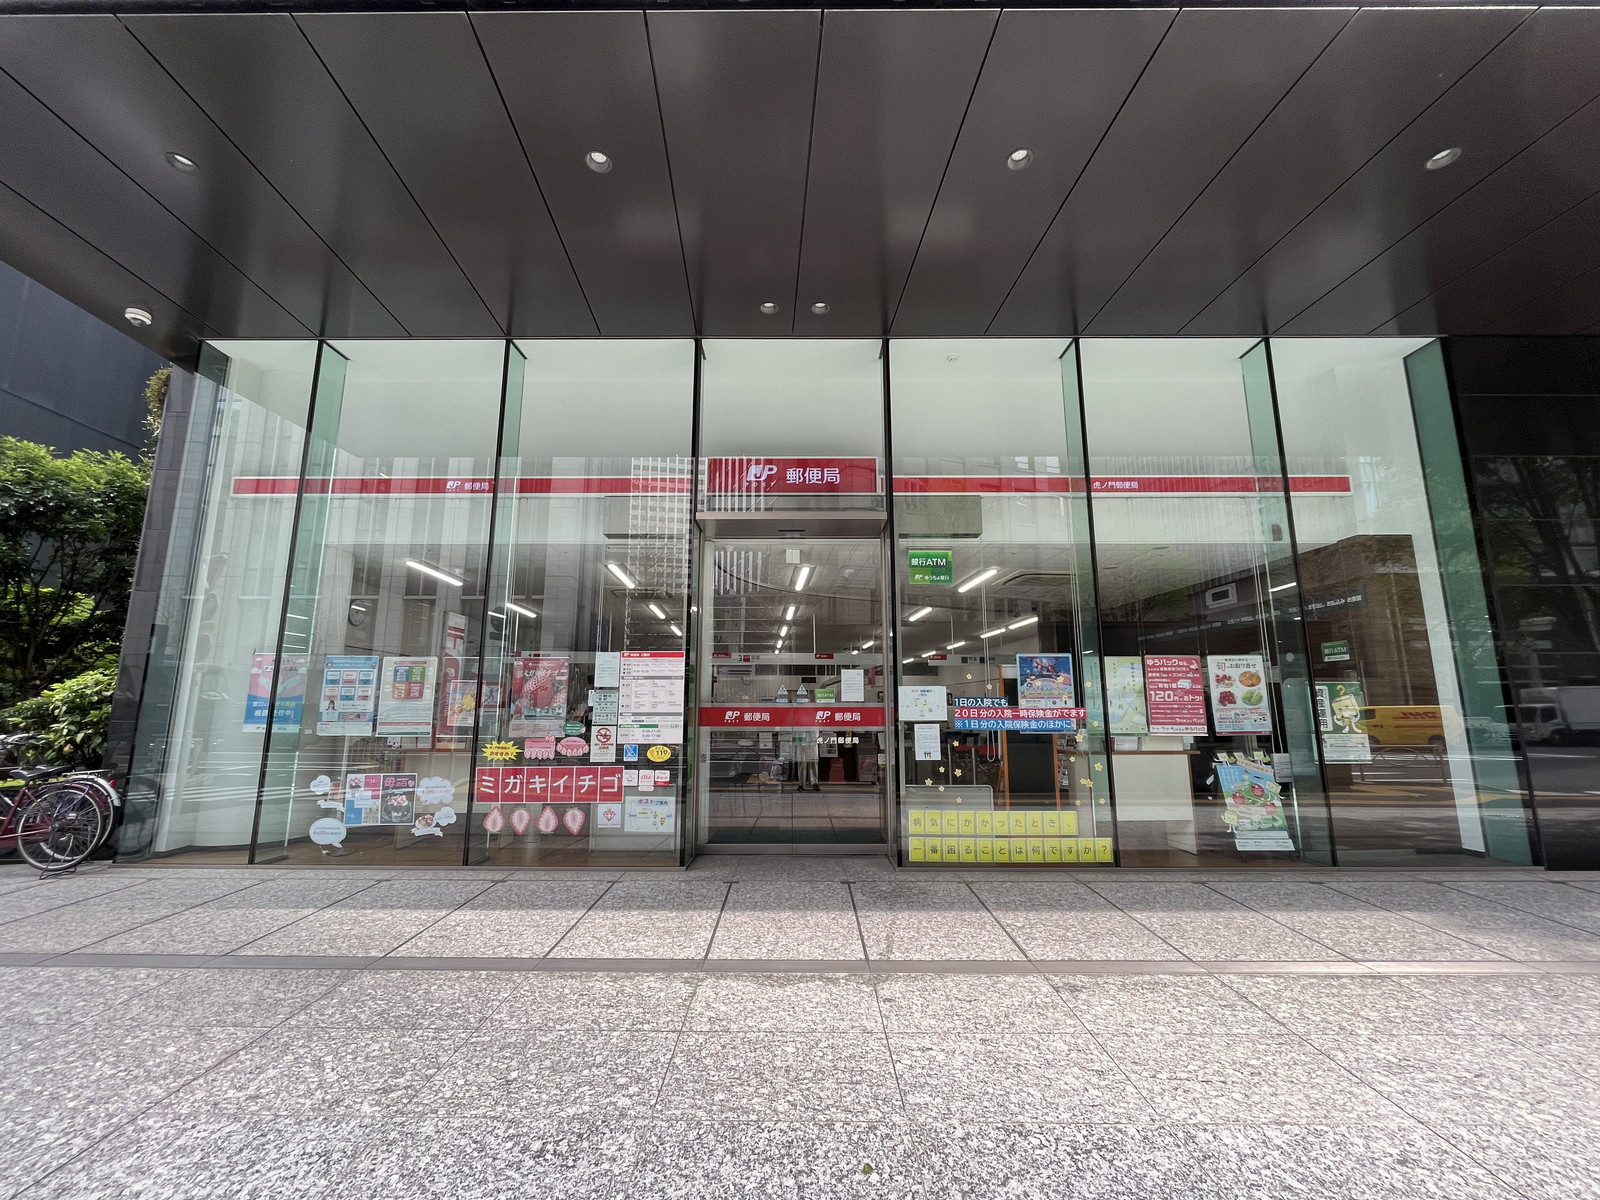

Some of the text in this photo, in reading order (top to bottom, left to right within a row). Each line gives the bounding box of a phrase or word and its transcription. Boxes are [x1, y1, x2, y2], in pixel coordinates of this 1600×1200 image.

[786, 467, 840, 485] 郵便局
[464, 481, 489, 490] 郵便局
[1093, 481, 1139, 490] 虎ノ門郵便局
[911, 557, 947, 566] 銀行ATM
[954, 698, 1009, 707] 1日の入院でも
[743, 712, 771, 721] 郵便局
[834, 712, 862, 721] 郵便局
[816, 736, 860, 744] 虎ノ門郵便局
[479, 773, 621, 794] ミガキイチゴ
[913, 817, 1071, 828] 病気にかかったとき、
[912, 845, 1108, 855] 一番困ることは何ですか?
